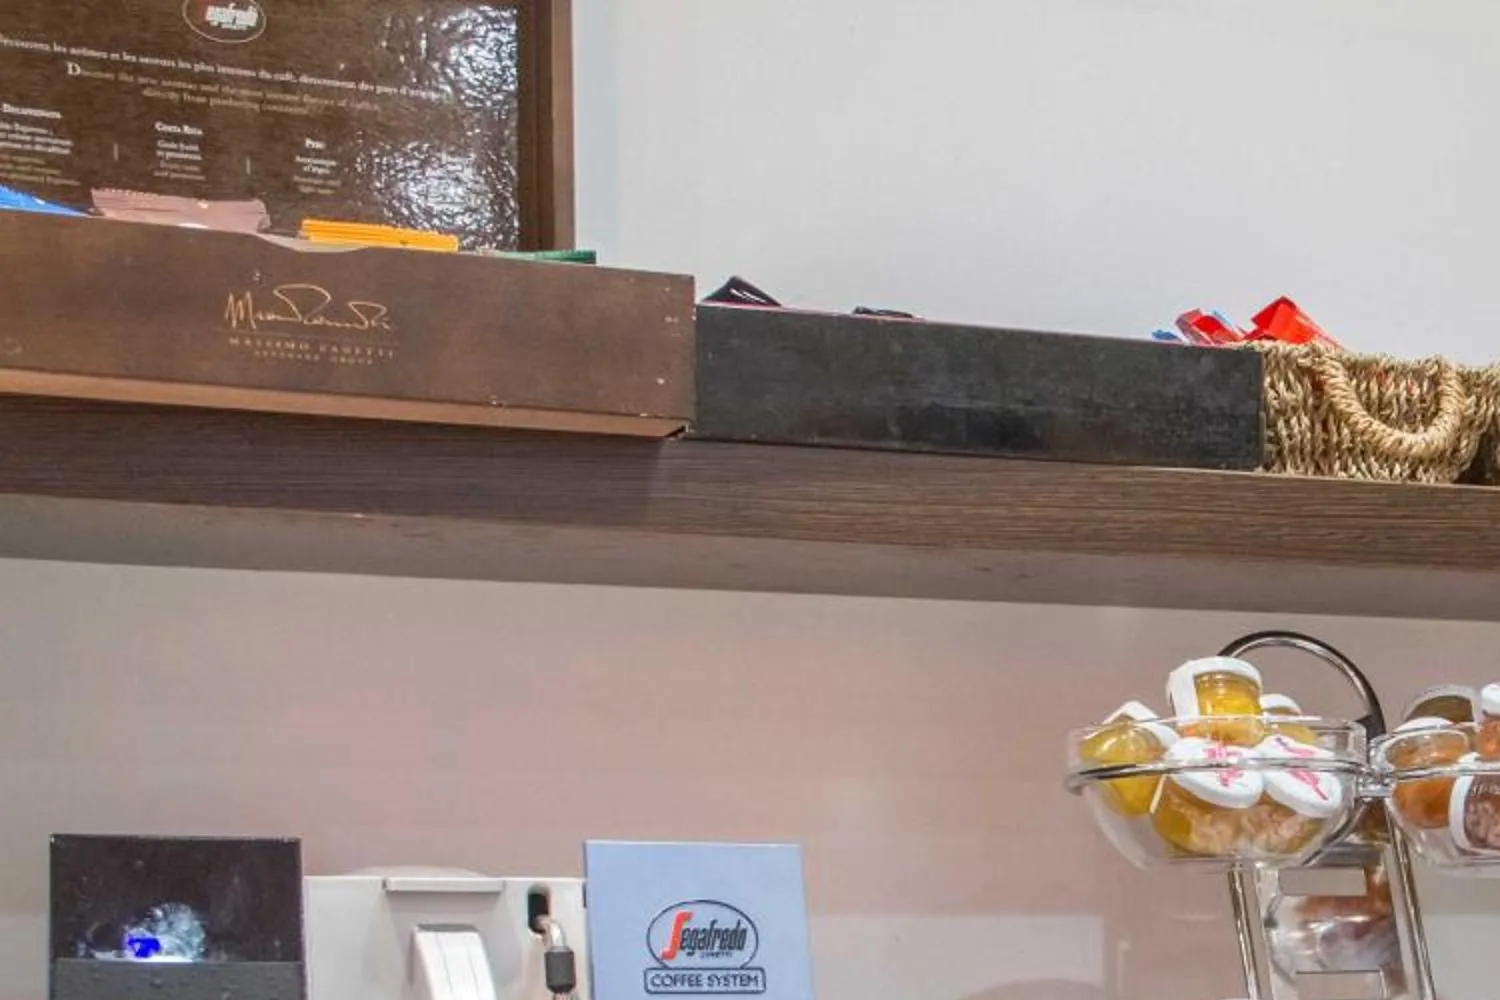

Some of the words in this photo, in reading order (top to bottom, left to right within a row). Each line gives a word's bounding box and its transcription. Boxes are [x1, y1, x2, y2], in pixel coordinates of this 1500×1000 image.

[660, 911, 748, 960] Segafredo
[651, 974, 703, 988] COFFEE
[707, 974, 759, 988] SYSTEM
